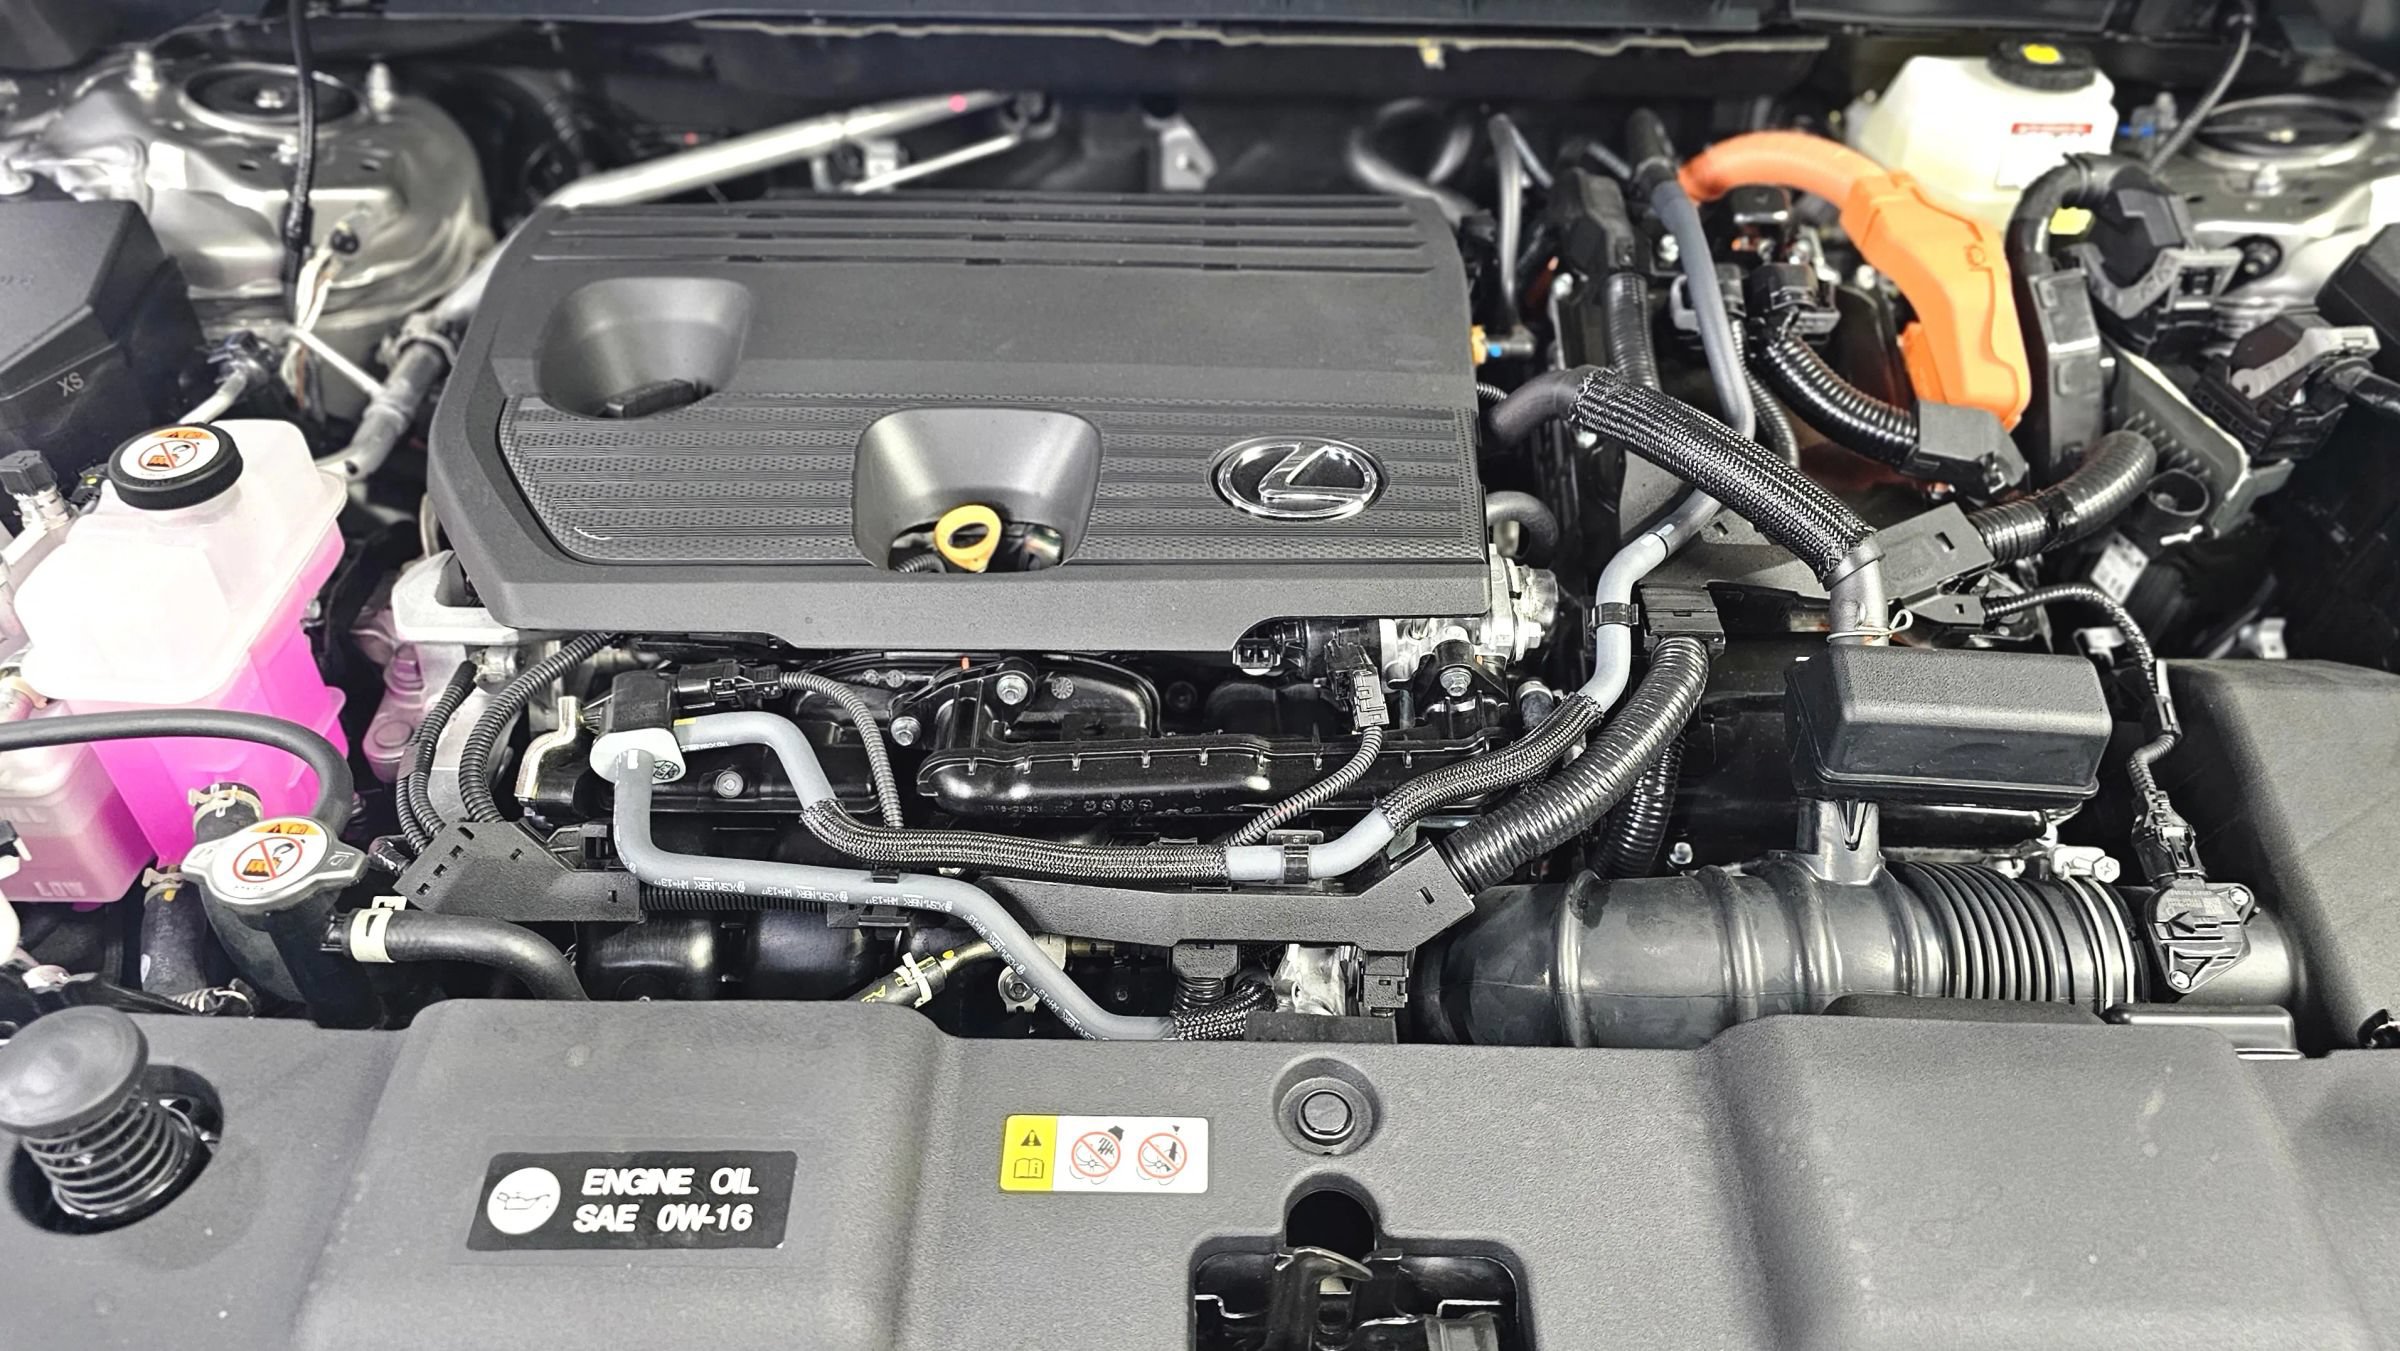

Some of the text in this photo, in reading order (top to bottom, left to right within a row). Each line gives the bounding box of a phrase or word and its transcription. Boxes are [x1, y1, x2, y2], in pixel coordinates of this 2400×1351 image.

[56, 372, 85, 397] XS
[34, 882, 86, 897] LOW
[581, 1167, 759, 1196] ENGINE OIL
[573, 1203, 754, 1233] SAE 0W-16
